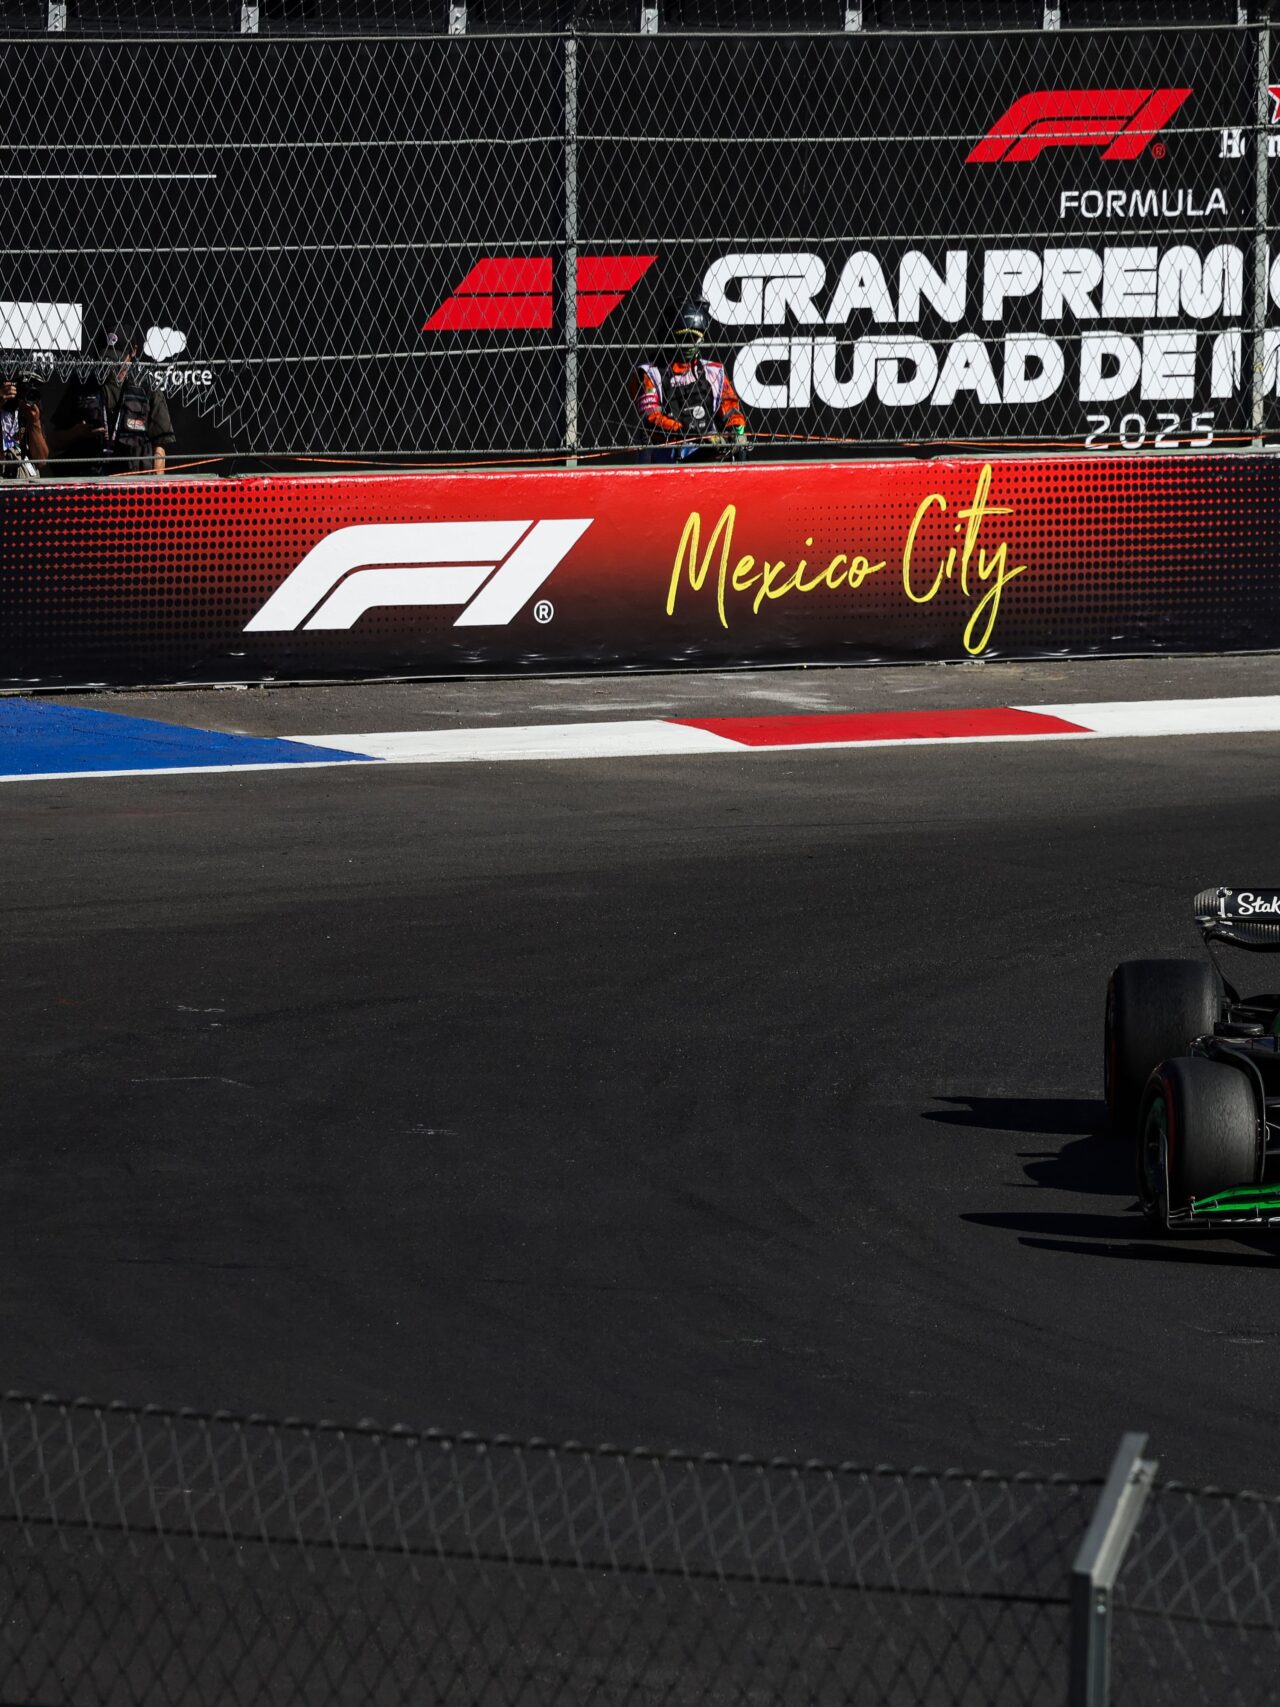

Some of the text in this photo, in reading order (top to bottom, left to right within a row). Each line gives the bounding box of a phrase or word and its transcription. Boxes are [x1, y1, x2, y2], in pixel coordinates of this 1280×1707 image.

[1060, 187, 1228, 218] FORMULA
[701, 250, 968, 325] GRAN
[147, 365, 213, 391] sforce
[733, 332, 1065, 409] CIUDAD
[1078, 329, 1198, 402] DE
[1085, 411, 1214, 450] 2025
[666, 463, 1027, 655] Mexico City
